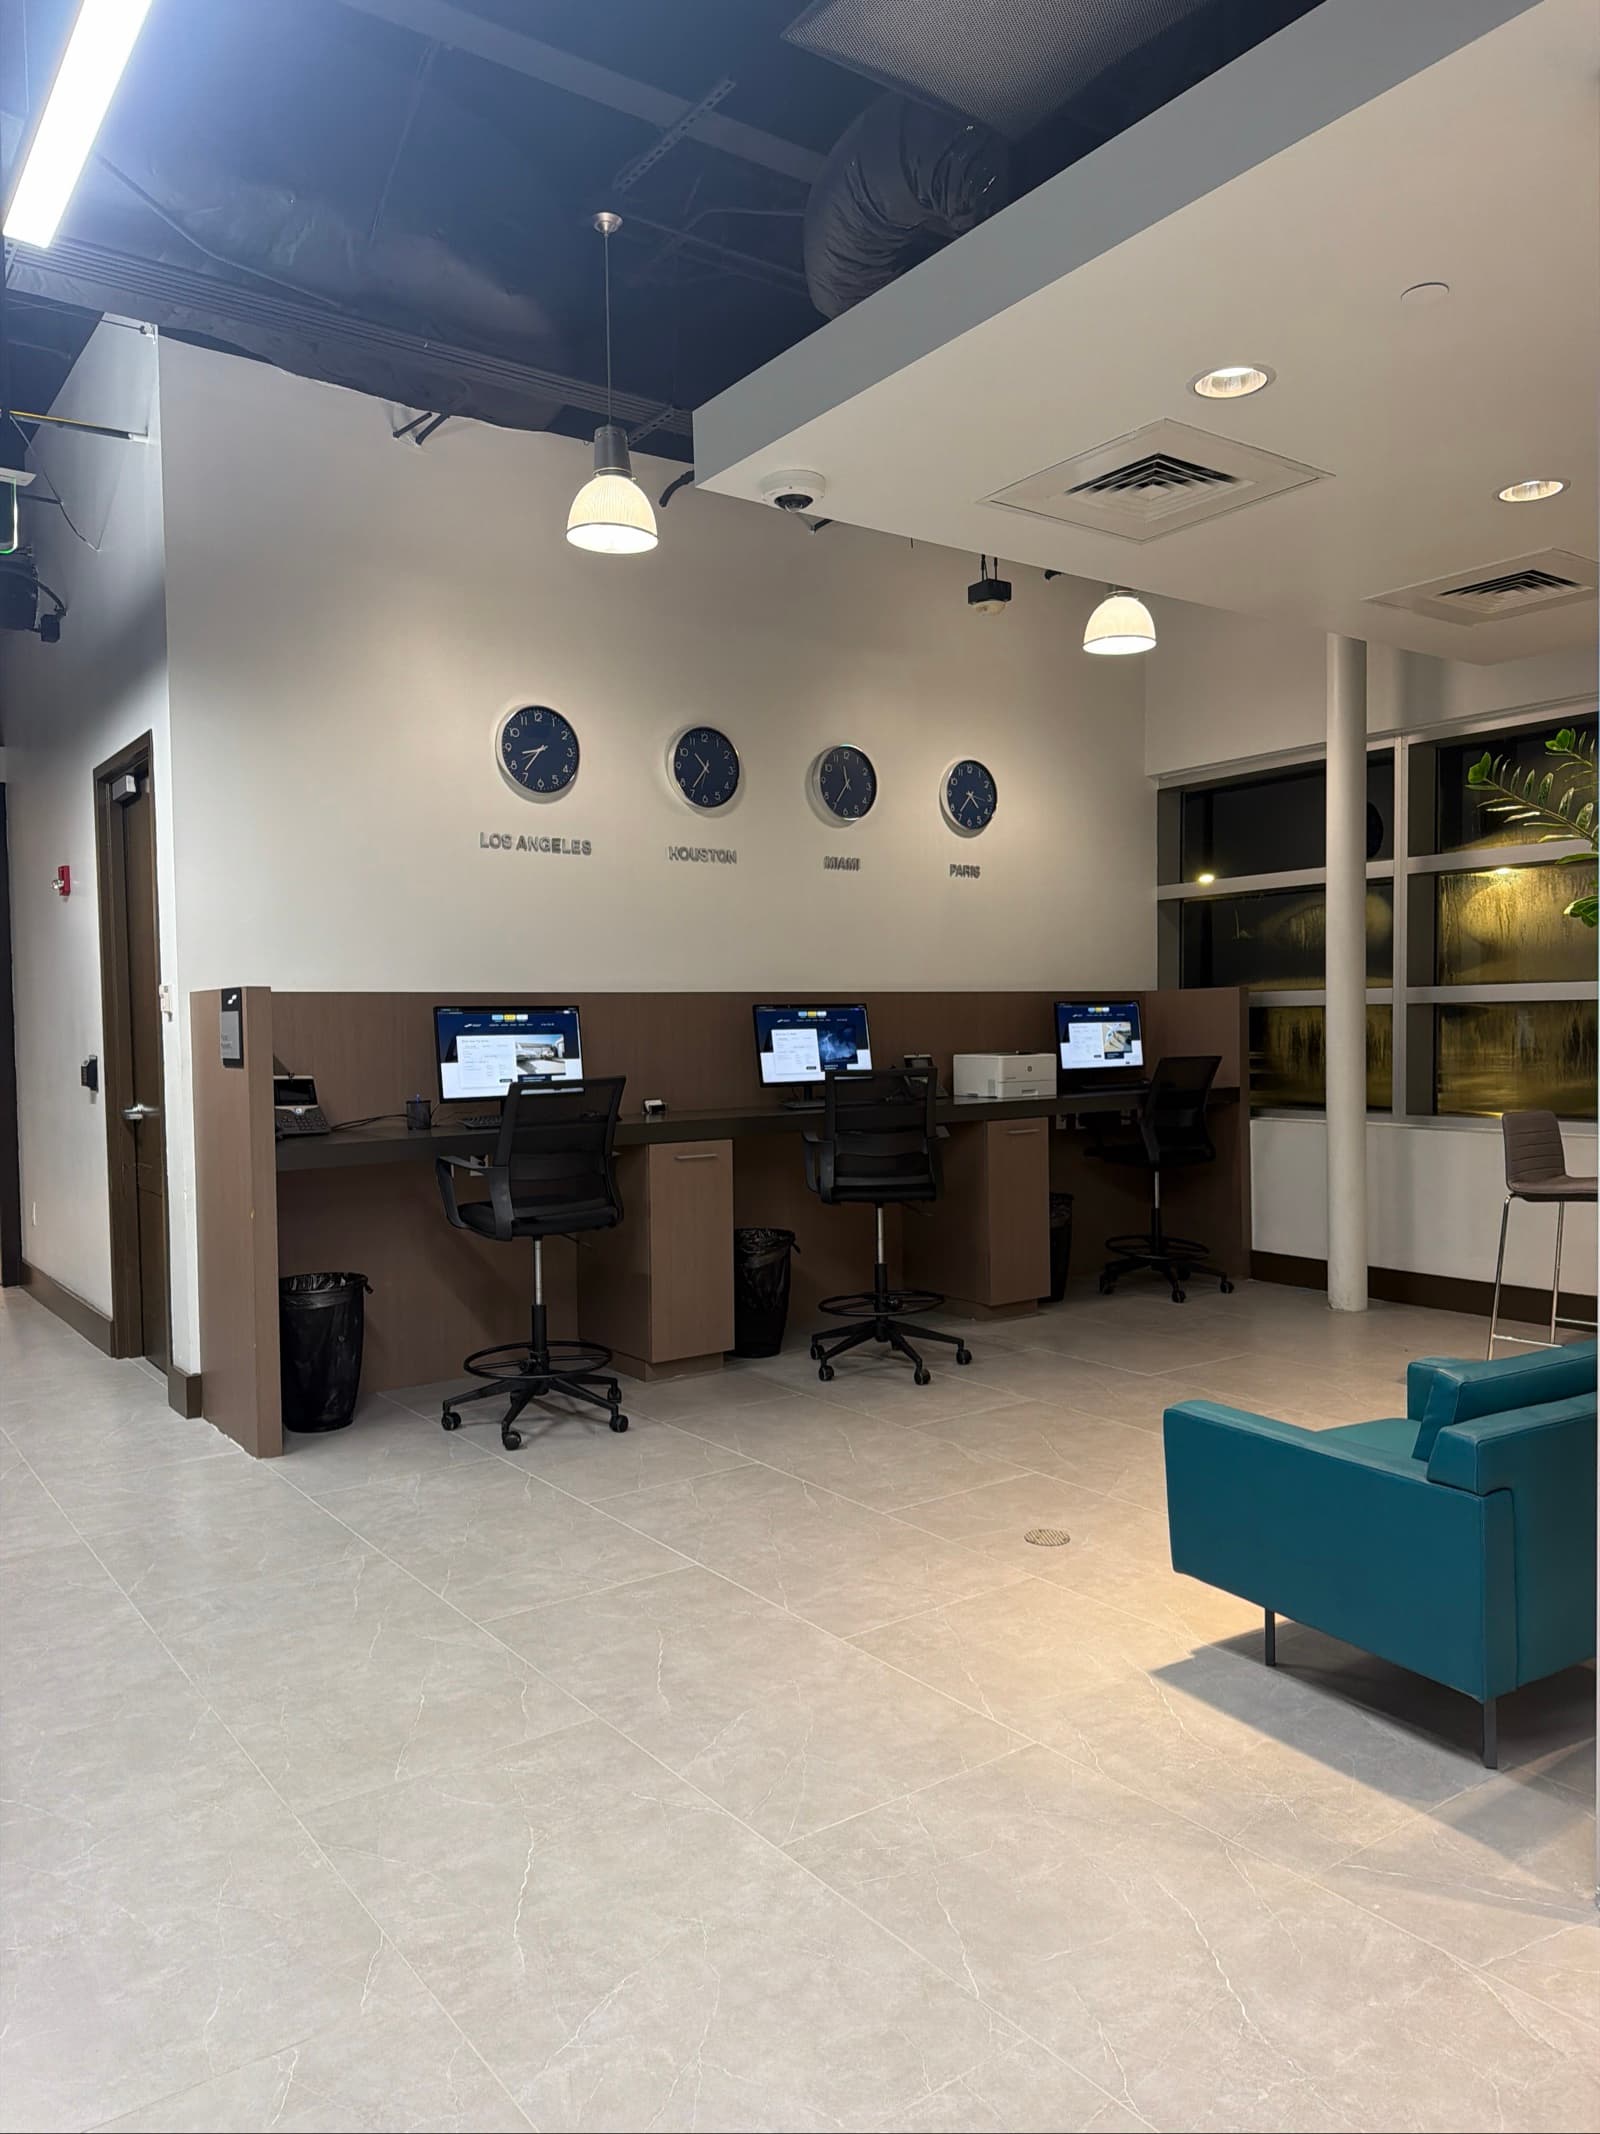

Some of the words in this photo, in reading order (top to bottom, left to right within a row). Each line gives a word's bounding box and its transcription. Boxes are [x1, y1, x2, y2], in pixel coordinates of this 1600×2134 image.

[479, 831, 512, 850] LOS
[515, 835, 592, 856] ANGELES
[668, 845, 737, 864] HOUSTON
[823, 855, 861, 872] MIAMI
[949, 863, 981, 879] PARIS
